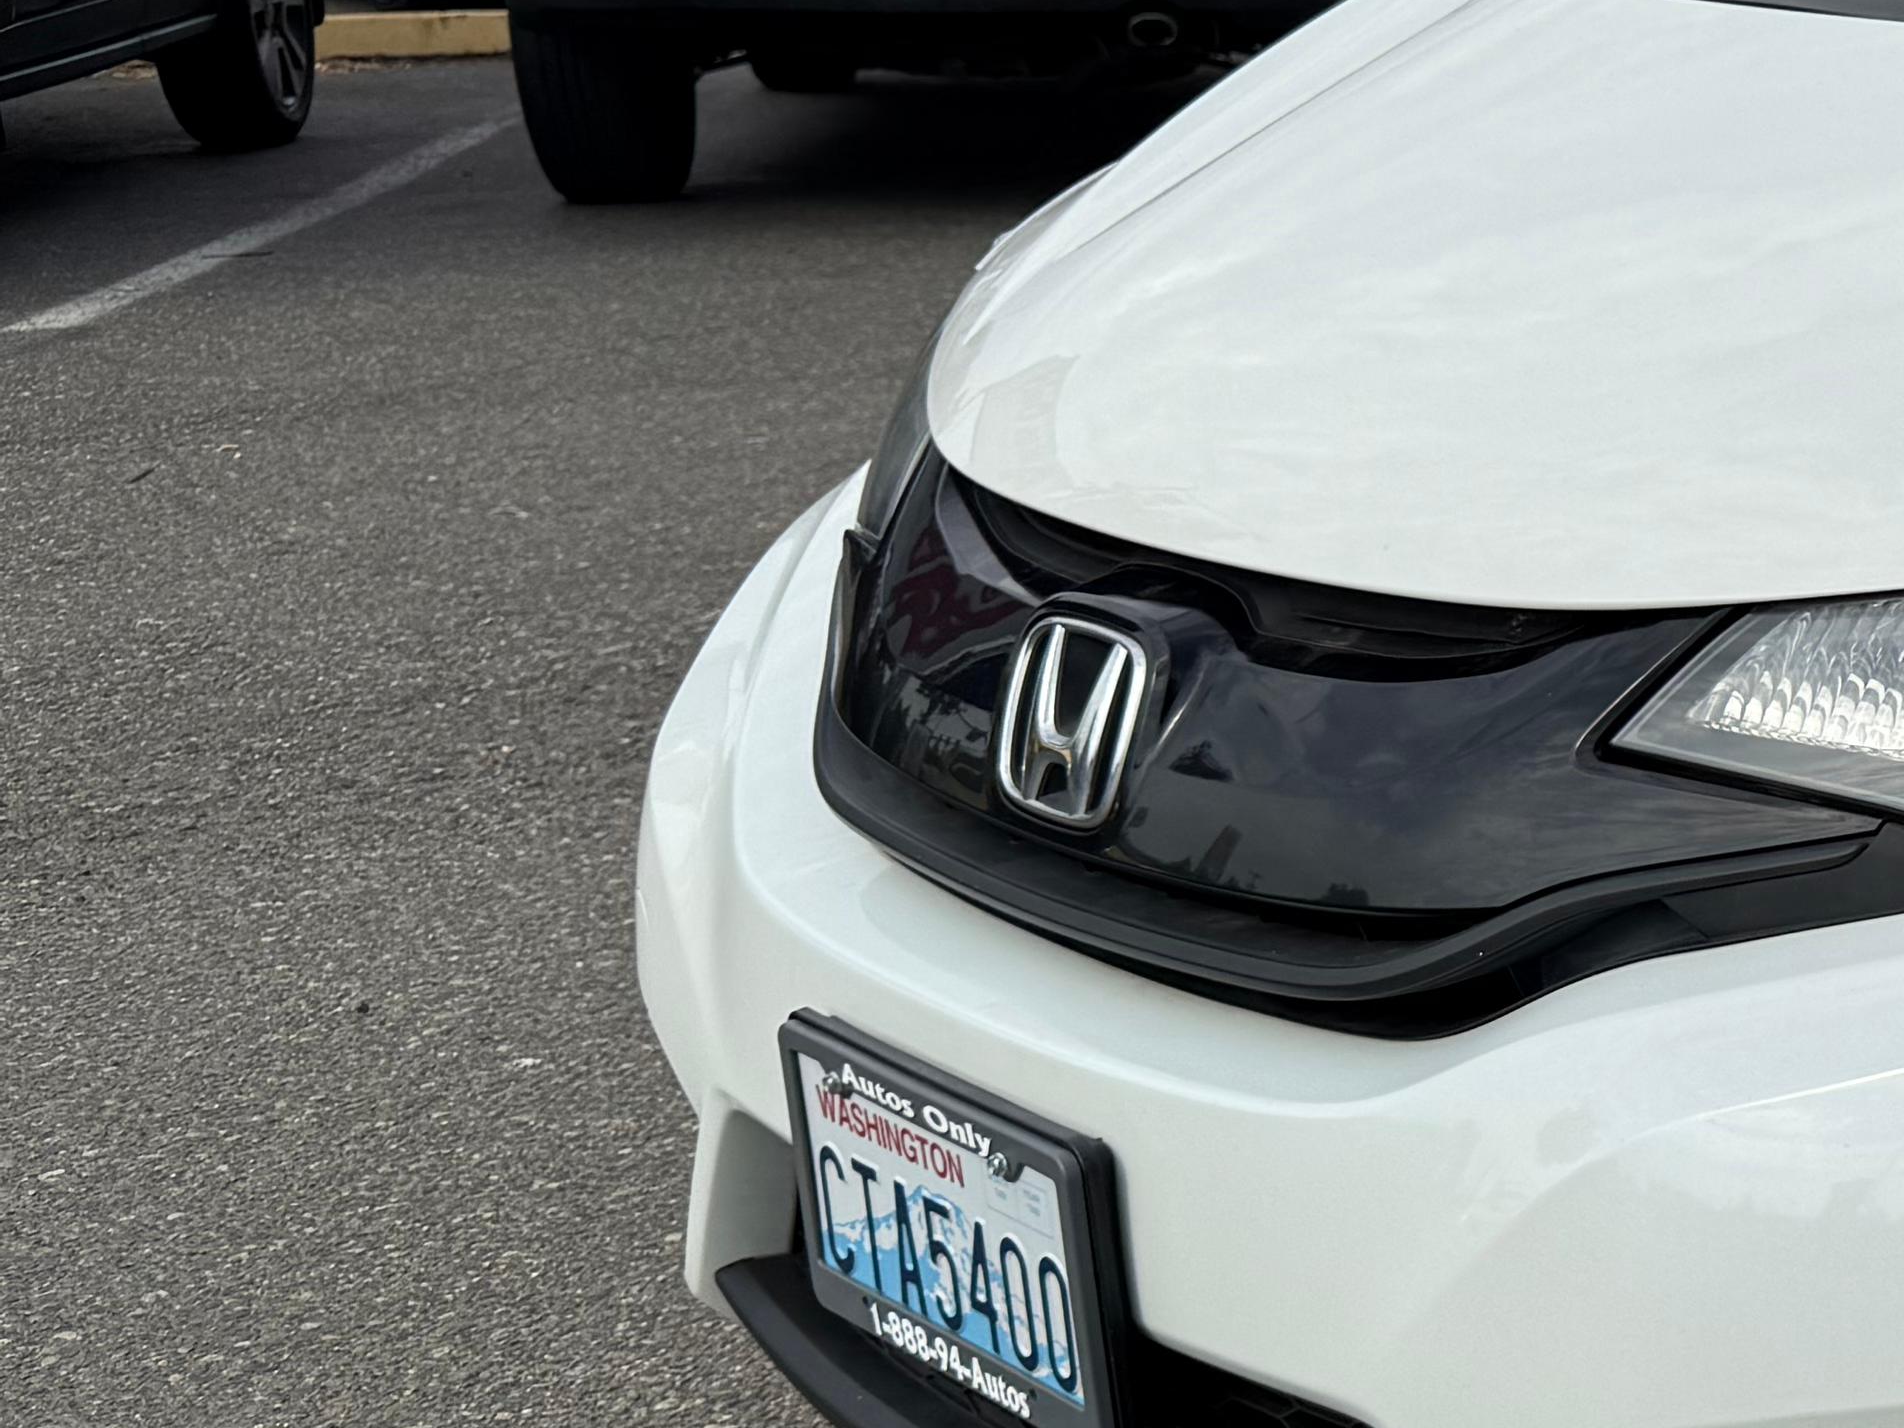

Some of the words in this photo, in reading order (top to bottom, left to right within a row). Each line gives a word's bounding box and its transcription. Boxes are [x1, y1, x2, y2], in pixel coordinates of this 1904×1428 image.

[815, 1083, 966, 1188] WASHINGTON
[840, 1062, 916, 1119] Autos
[923, 1104, 993, 1158] Only
[818, 1144, 1080, 1394] CTA5400
[868, 1301, 1033, 1419] 1-888-94-Autos
